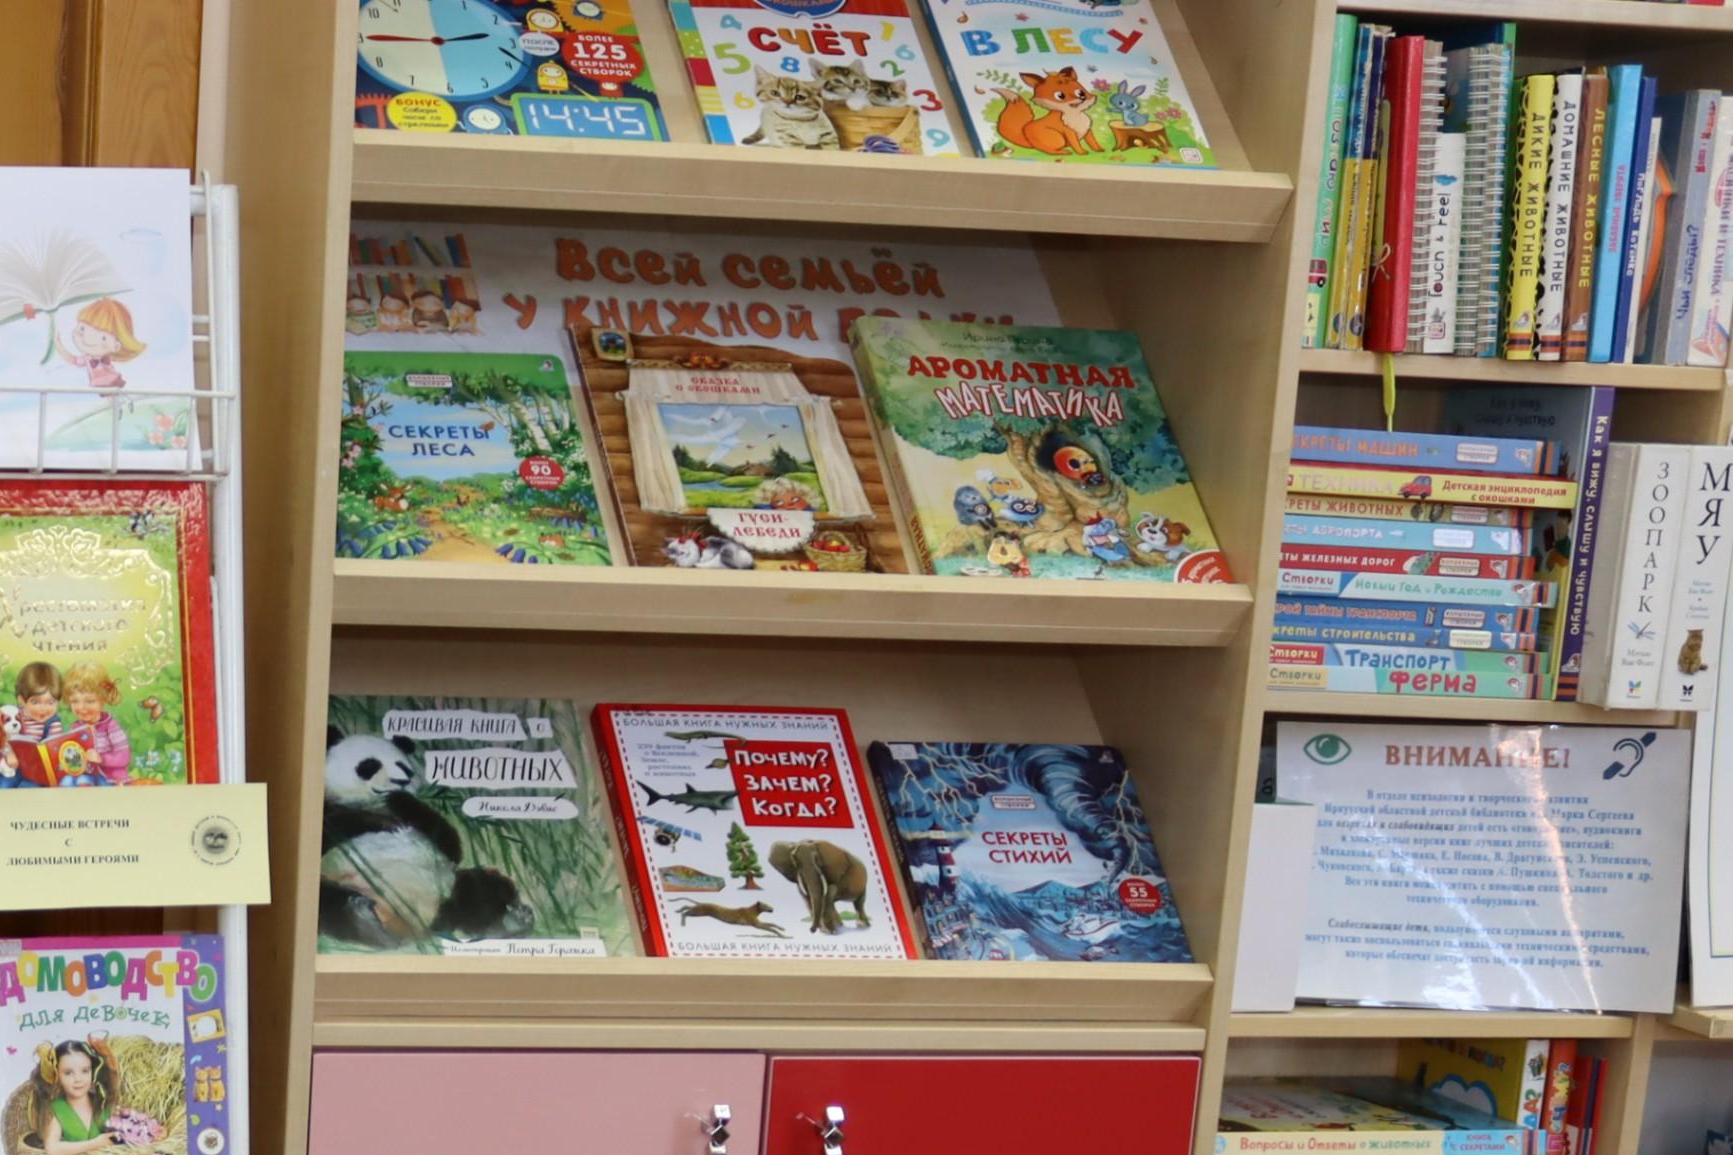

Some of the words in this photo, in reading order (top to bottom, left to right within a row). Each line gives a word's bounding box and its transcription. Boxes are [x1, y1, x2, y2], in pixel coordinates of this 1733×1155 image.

[578, 35, 614, 43] БОЛЕЕ
[748, 22, 870, 57] СЧЁТ
[960, 29, 1000, 57] В
[1012, 27, 1143, 56] ЛЕСУ
[574, 42, 627, 60] 125
[570, 60, 636, 69] СЕКРЕТНЫХ
[579, 67, 632, 77] СТВОРОК
[528, 103, 646, 136] 14:45
[1529, 113, 1546, 169] ДИКИЕ
[1558, 100, 1576, 192] ДОМАШНИЕ
[1588, 108, 1605, 183] ЛЕСНЫЕ
[1520, 182, 1539, 277] ЖИВОТНЫЕ
[1550, 203, 1568, 292] ЖИВОТНЫЕ
[1579, 194, 1597, 288] ЖИВОТНЫЕ
[907, 354, 1136, 388] АРОМАТНАЯ
[936, 381, 1125, 427] МАТЕМАТИКА
[389, 425, 490, 440] СЕКРЕТЫ
[412, 443, 475, 457] ЛЕСА
[530, 465, 551, 476] 90
[1443, 480, 1485, 492] Детская
[1487, 483, 1567, 496] энциклопедия
[1696, 462, 1733, 565] МЯУ
[732, 525, 801, 540] ЛЕБЕДИ
[1638, 462, 1669, 613] ЗООПАРК
[1302, 553, 1358, 565] ЖЕЛЕЗНЫХ
[1361, 556, 1395, 567] ДОРОГ
[388, 717, 463, 734] КРАСИВАЯ
[471, 717, 517, 733] КНИГА
[623, 718, 680, 727] БОЛЬШАЯ
[684, 718, 722, 727] КНИГА
[725, 720, 777, 730] НУЖНЫХ
[782, 720, 829, 730] ЗНАНИЙ
[432, 756, 564, 781] ЖИВОТНЫХ
[11, 819, 74, 831] ЧУДЕСНЫЕ
[78, 818, 130, 829] ВСТРЕЧИ
[982, 831, 1067, 846] СЕКРЕТЫ
[6, 855, 80, 866] ЛЮБИМЫМИ
[84, 854, 139, 864] ГЕРОЯМИ
[989, 847, 1072, 864] СТИХИЙ
[1129, 888, 1148, 897] 55
[1240, 1136, 1294, 1152] Вопросы
[1308, 1136, 1356, 1150] Ответы
[1369, 1139, 1432, 1150] животных
